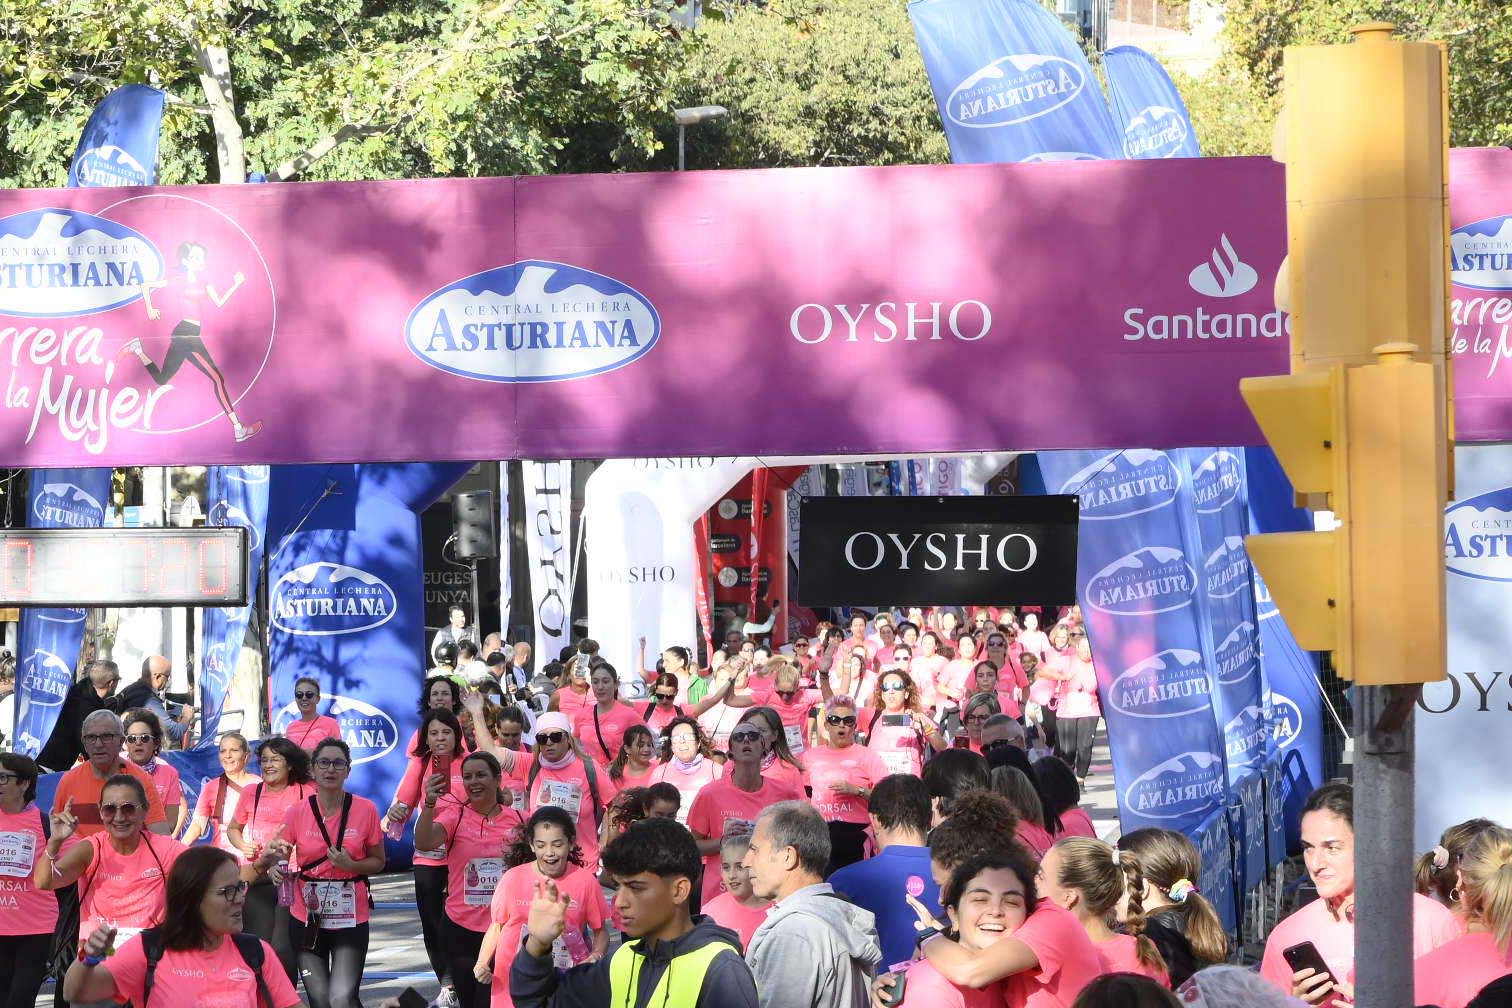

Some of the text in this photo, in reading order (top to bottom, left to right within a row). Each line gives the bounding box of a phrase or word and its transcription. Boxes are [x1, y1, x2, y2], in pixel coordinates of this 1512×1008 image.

[66, 243, 140, 256] LECHERA
[1464, 240, 1512, 250] CENTRA
[464, 300, 633, 317] CENTRAL LECHERA
[789, 299, 992, 344] OYSHO
[1451, 296, 1512, 325] arre
[423, 307, 640, 353] ASTURIANA
[1123, 306, 1292, 341] Santand
[1472, 327, 1492, 354] la
[5, 370, 31, 409] la
[24, 360, 175, 455] Mujer
[1470, 519, 1512, 530] CENT
[844, 531, 1038, 572] OYSHO
[288, 586, 384, 596] CENTRAL LECHERA
[273, 591, 389, 619] ASTURIANA
[0, 848, 17, 856] 016
